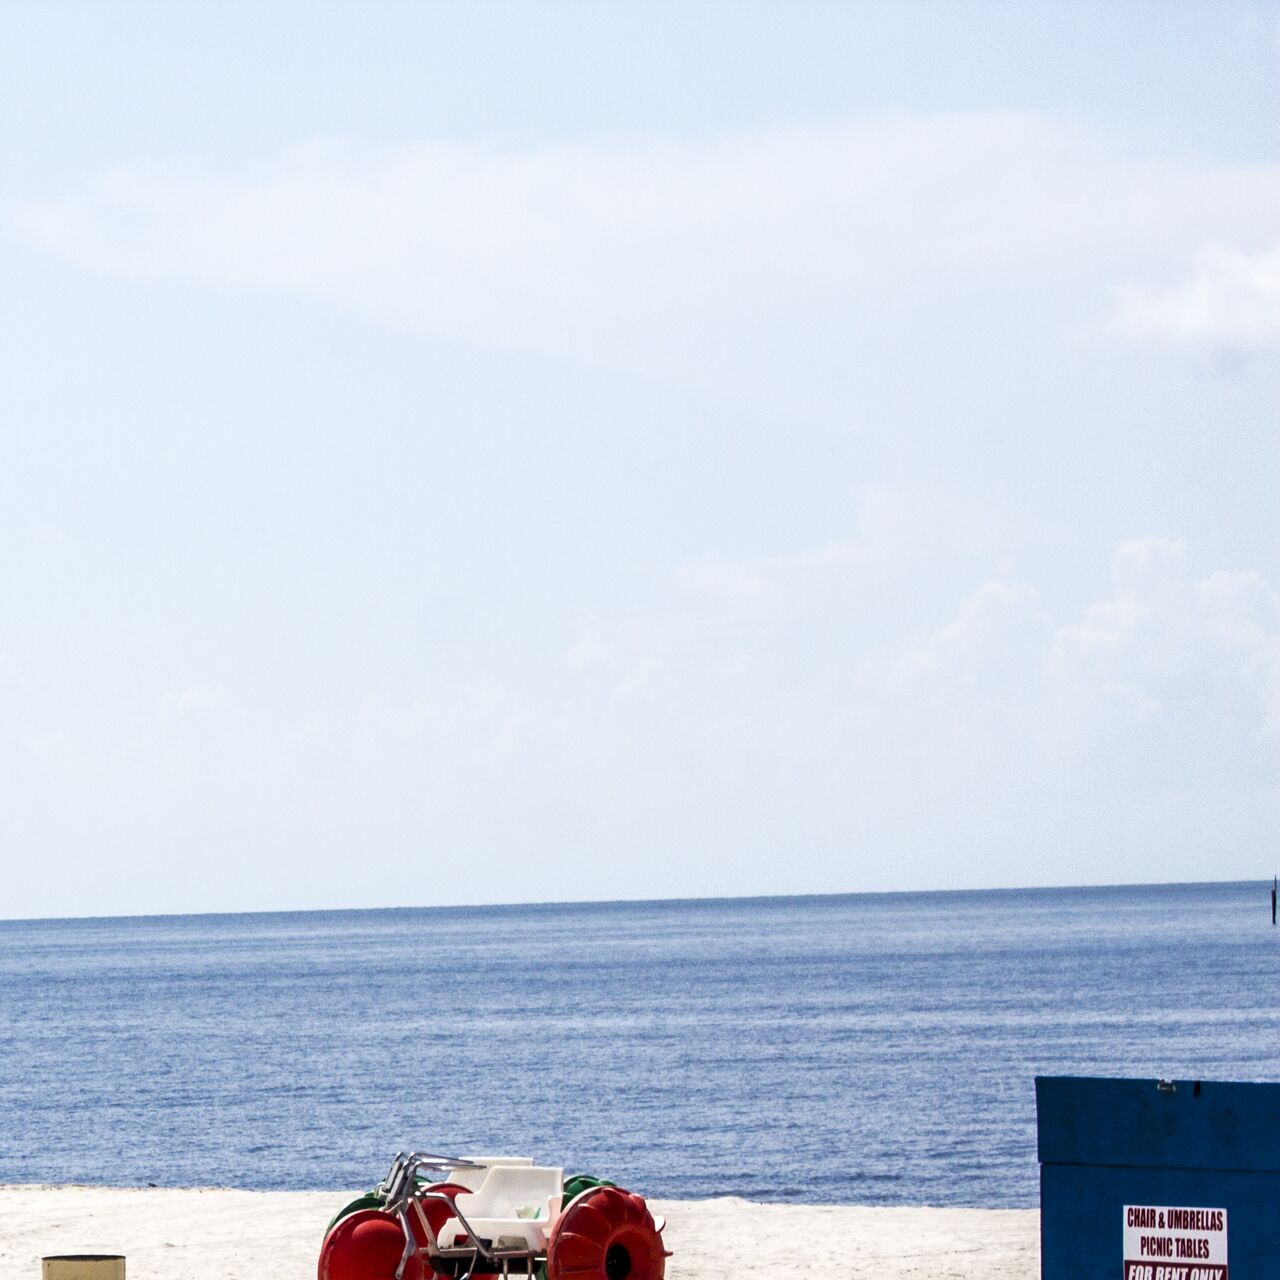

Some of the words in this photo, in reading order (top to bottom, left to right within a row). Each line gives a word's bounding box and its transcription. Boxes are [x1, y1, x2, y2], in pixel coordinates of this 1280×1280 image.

[1127, 1207, 1157, 1228] CHAIR
[1158, 1212, 1166, 1229] &
[1167, 1209, 1224, 1232] UMBRELLAS
[1140, 1236, 1173, 1257] PICNIC
[1175, 1238, 1210, 1259] TABLES
